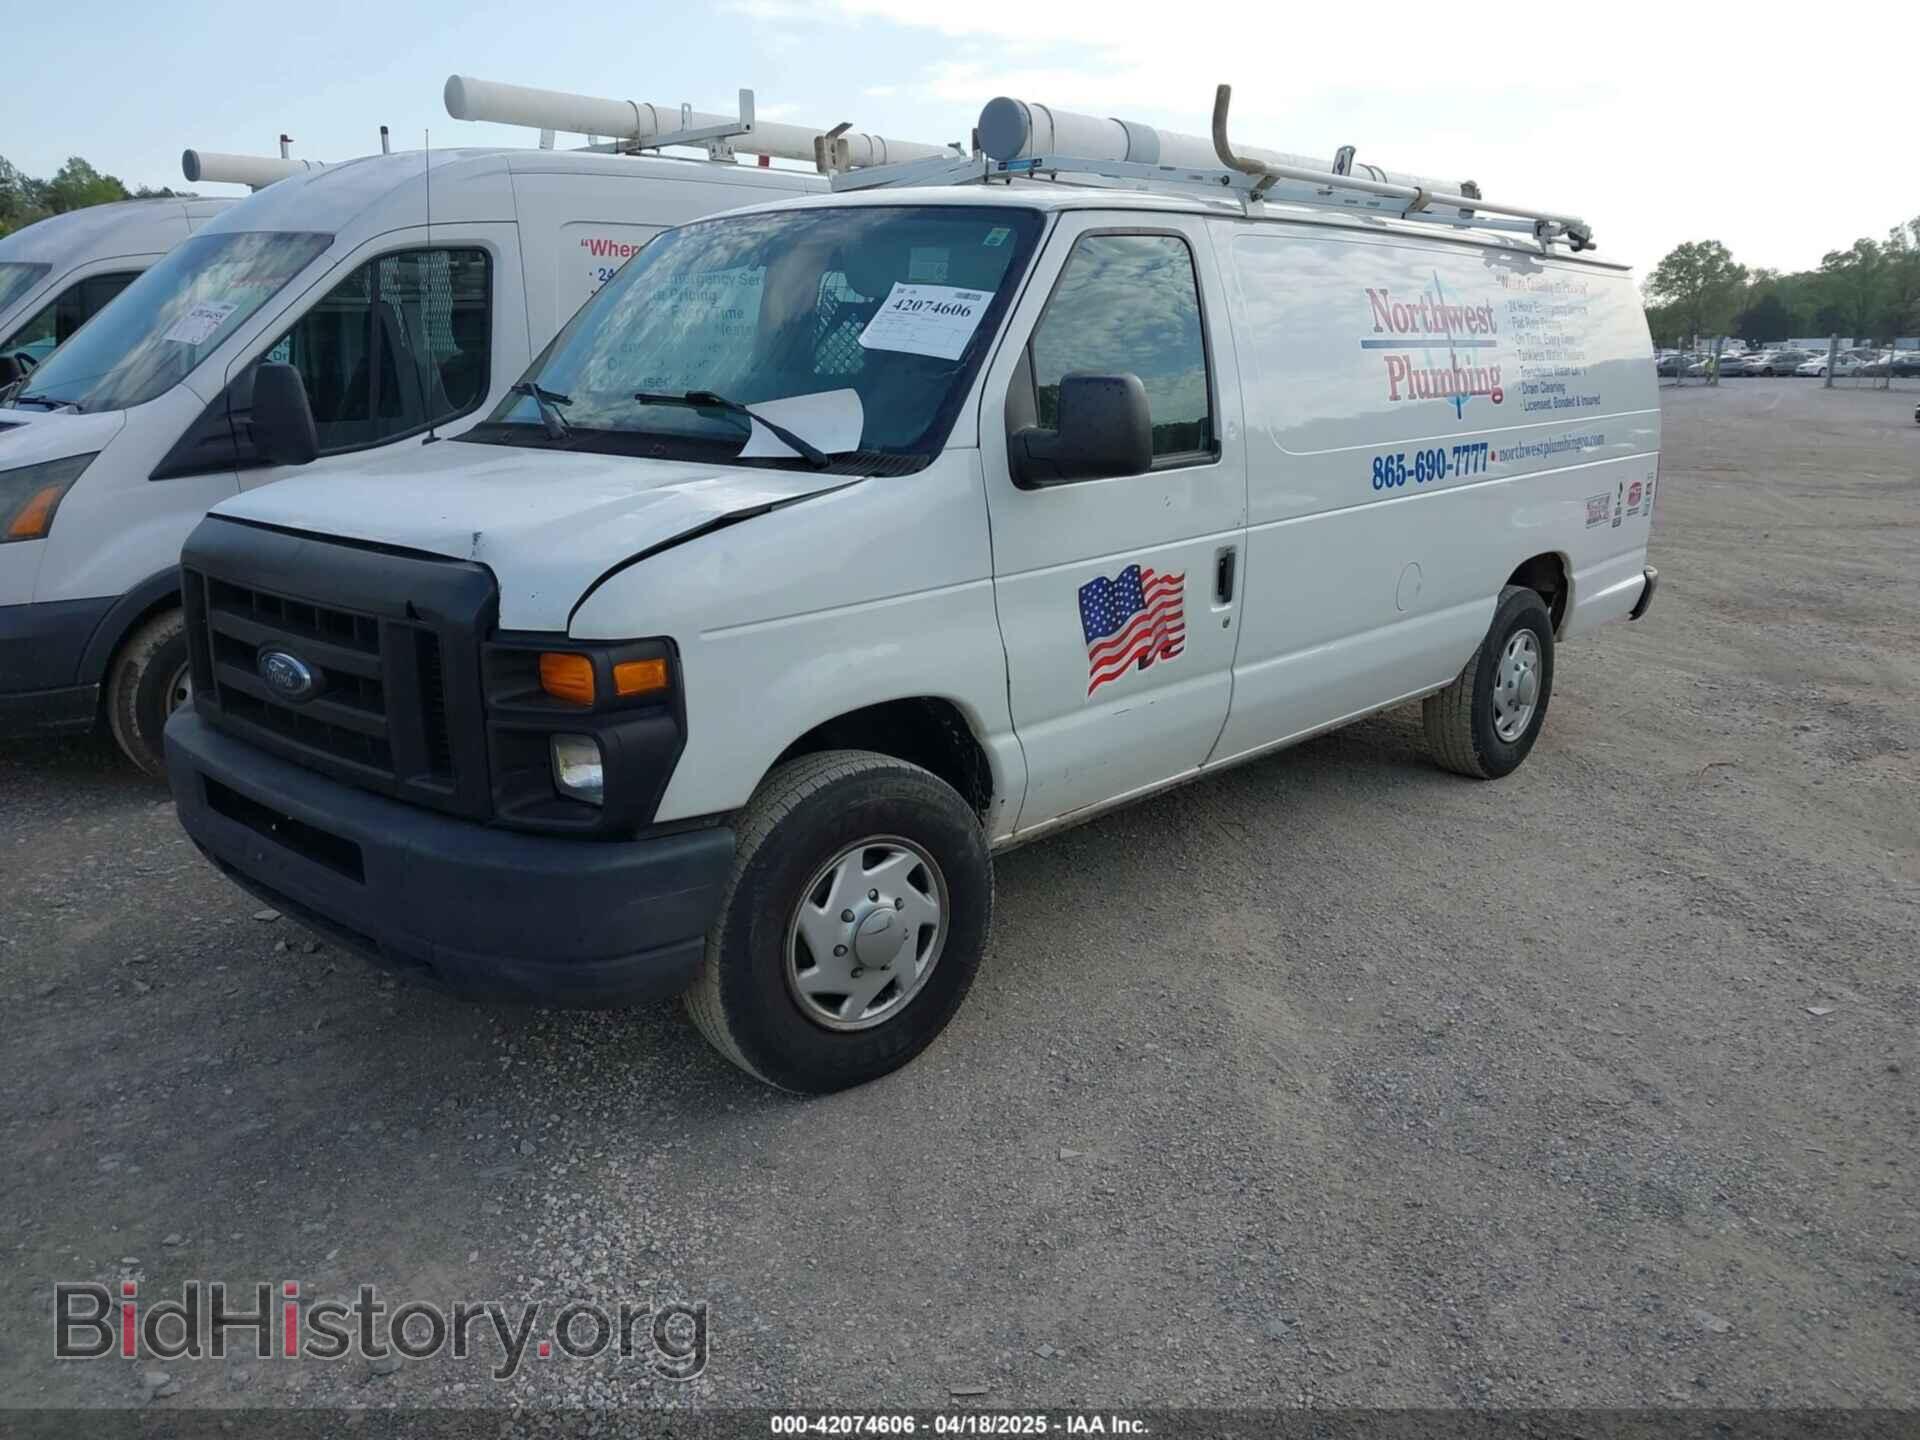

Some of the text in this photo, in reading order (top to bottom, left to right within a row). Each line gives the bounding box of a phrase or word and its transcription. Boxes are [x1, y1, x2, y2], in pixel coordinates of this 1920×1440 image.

[893, 298, 971, 317] 42074606
[1364, 287, 1497, 335] Northwest
[1383, 354, 1504, 404] Plumbing
[1372, 442, 1488, 490] 865-690-7777
